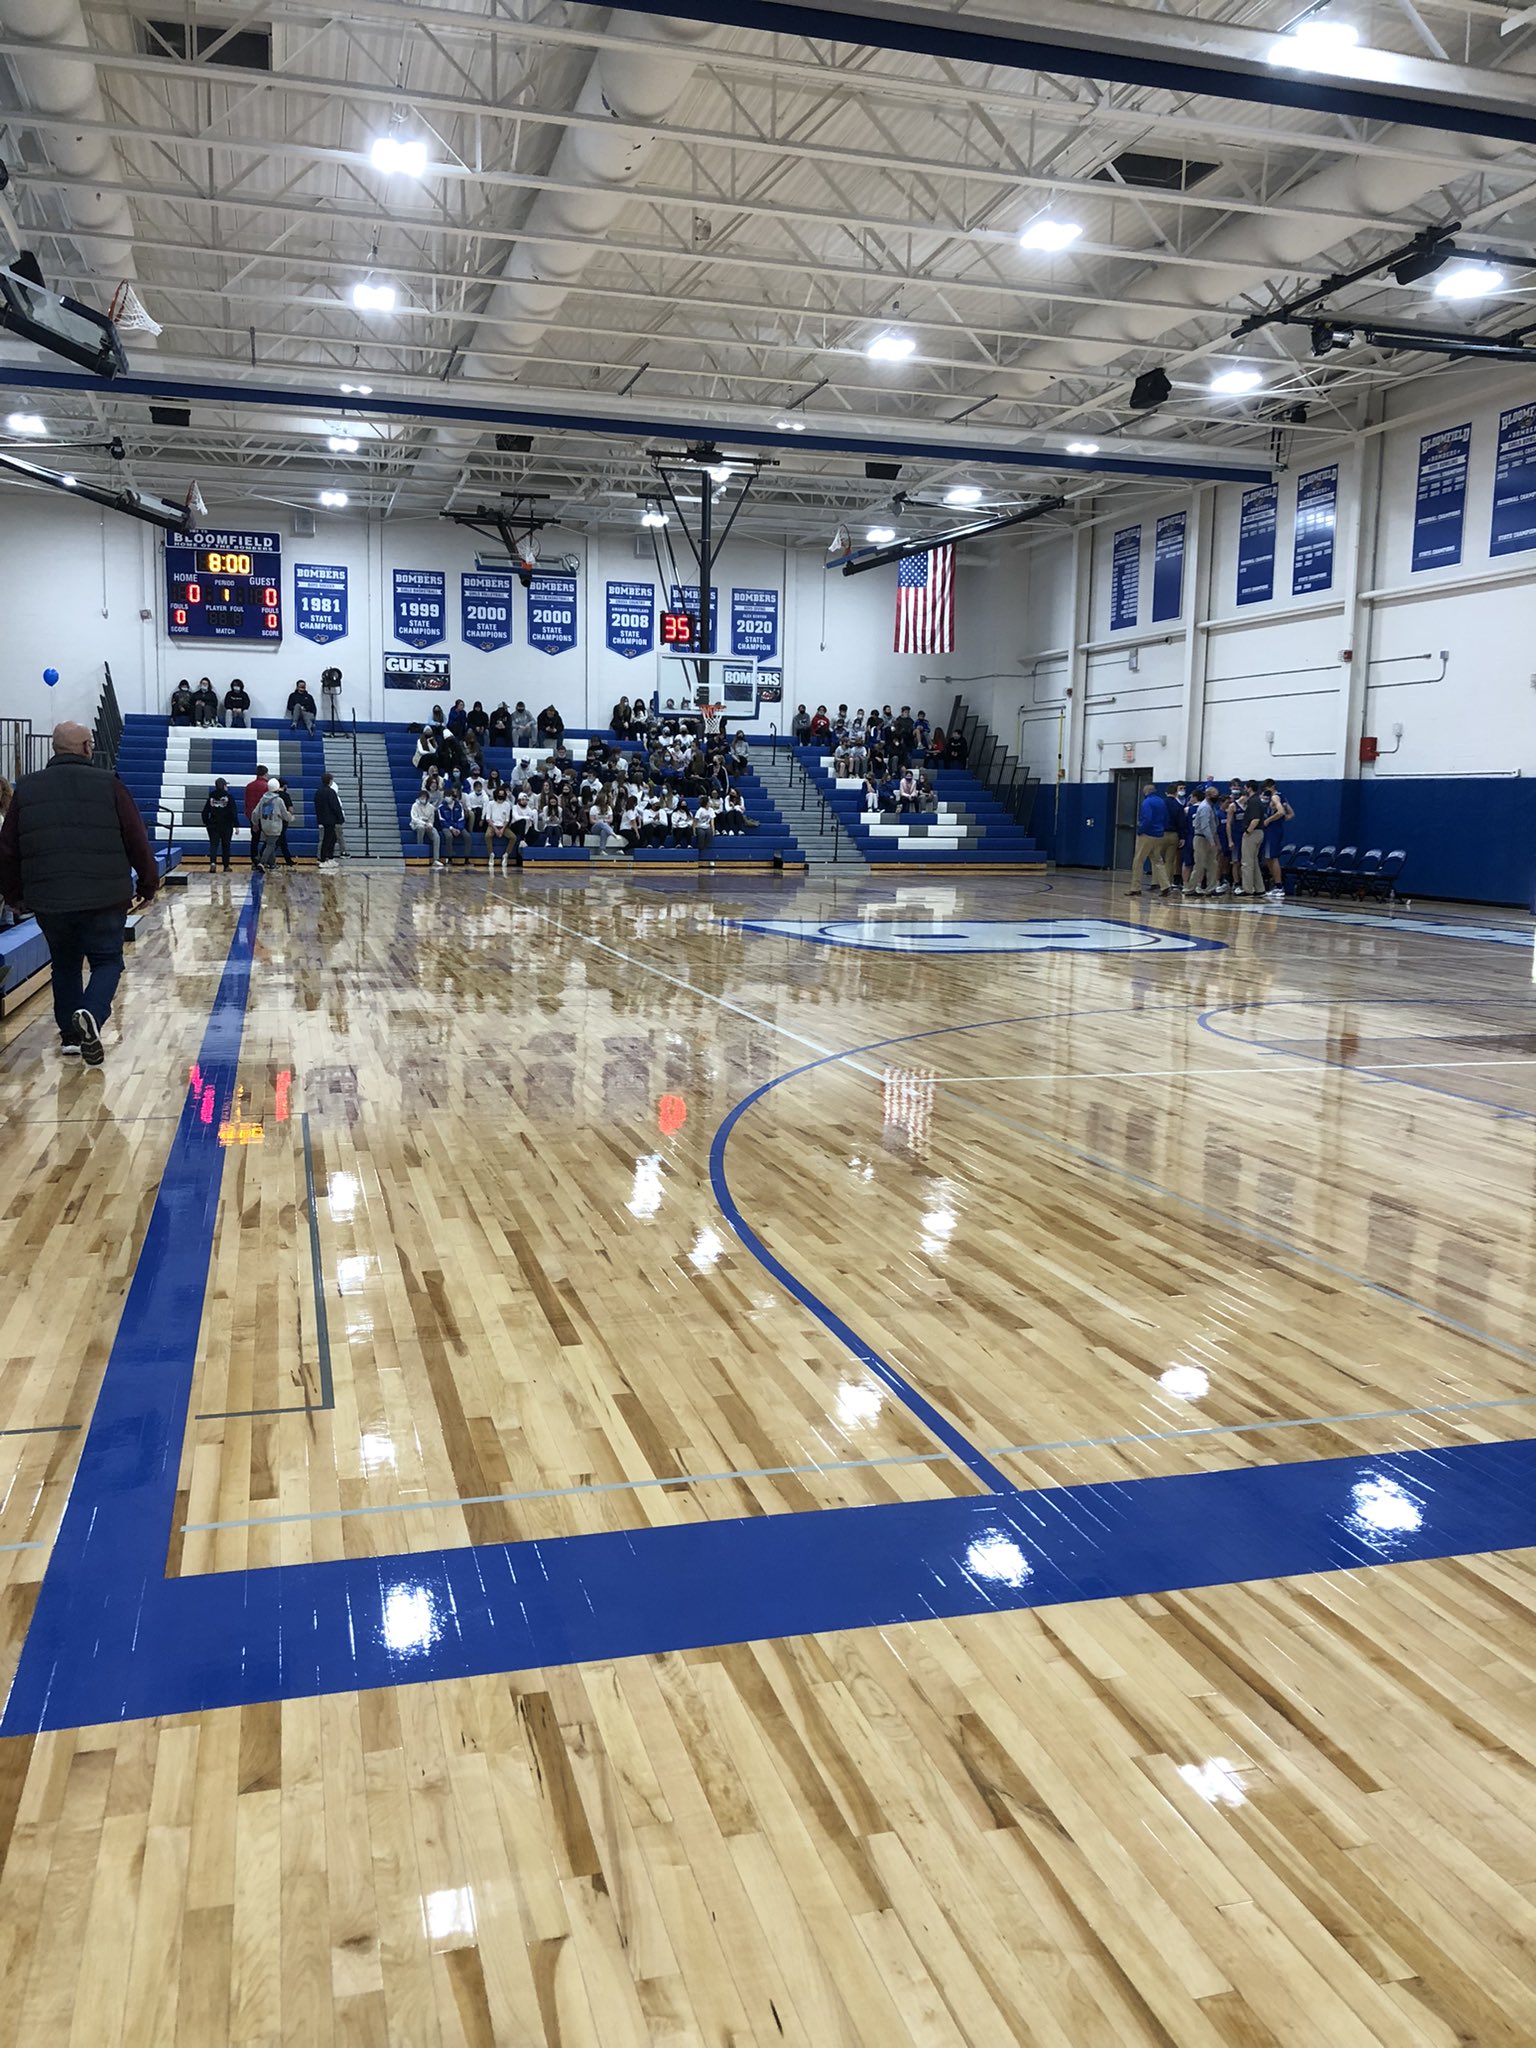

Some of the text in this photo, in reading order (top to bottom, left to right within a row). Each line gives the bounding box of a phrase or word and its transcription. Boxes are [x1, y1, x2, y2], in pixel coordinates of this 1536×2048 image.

[174, 532, 273, 547] BLOOMFIELD
[208, 553, 250, 574] 8:00
[174, 573, 198, 582] HOME
[296, 568, 345, 580] BOMBERS
[395, 574, 442, 585] BOMBERS
[249, 577, 276, 586] GUEST
[463, 577, 510, 589] BOMBERS
[529, 581, 575, 592] BOMBERS
[188, 584, 201, 603] 0
[224, 588, 230, 602] 1
[265, 588, 277, 606] 0
[608, 586, 653, 597] BOMBERS
[672, 590, 716, 600] BMBS
[734, 592, 776, 604] BOMBERS
[206, 604, 227, 612] PLAYER
[301, 597, 340, 613] 1981
[400, 602, 440, 618] 1999
[176, 609, 186, 624] 0
[310, 614, 332, 623] STATE
[467, 605, 507, 621] 2000
[533, 609, 572, 624] 2000
[267, 613, 278, 628] 0
[300, 621, 343, 631] CHAMPIONS
[409, 619, 430, 627] STATE
[611, 613, 649, 628] 2008
[398, 627, 441, 636] CHAMPIONS
[477, 623, 497, 631] STATE
[542, 626, 562, 634] STATE
[665, 616, 690, 639] 35
[736, 619, 773, 634] 2020
[466, 630, 508, 639] CHAMPIONS
[532, 633, 572, 642] CHAMPIONS
[620, 630, 640, 638] STATE
[612, 637, 648, 646] CHAMPION
[745, 636, 764, 644] STATE
[737, 643, 771, 651] CHAMPION
[386, 658, 448, 673] GUEST
[724, 671, 780, 685] BOMERS
